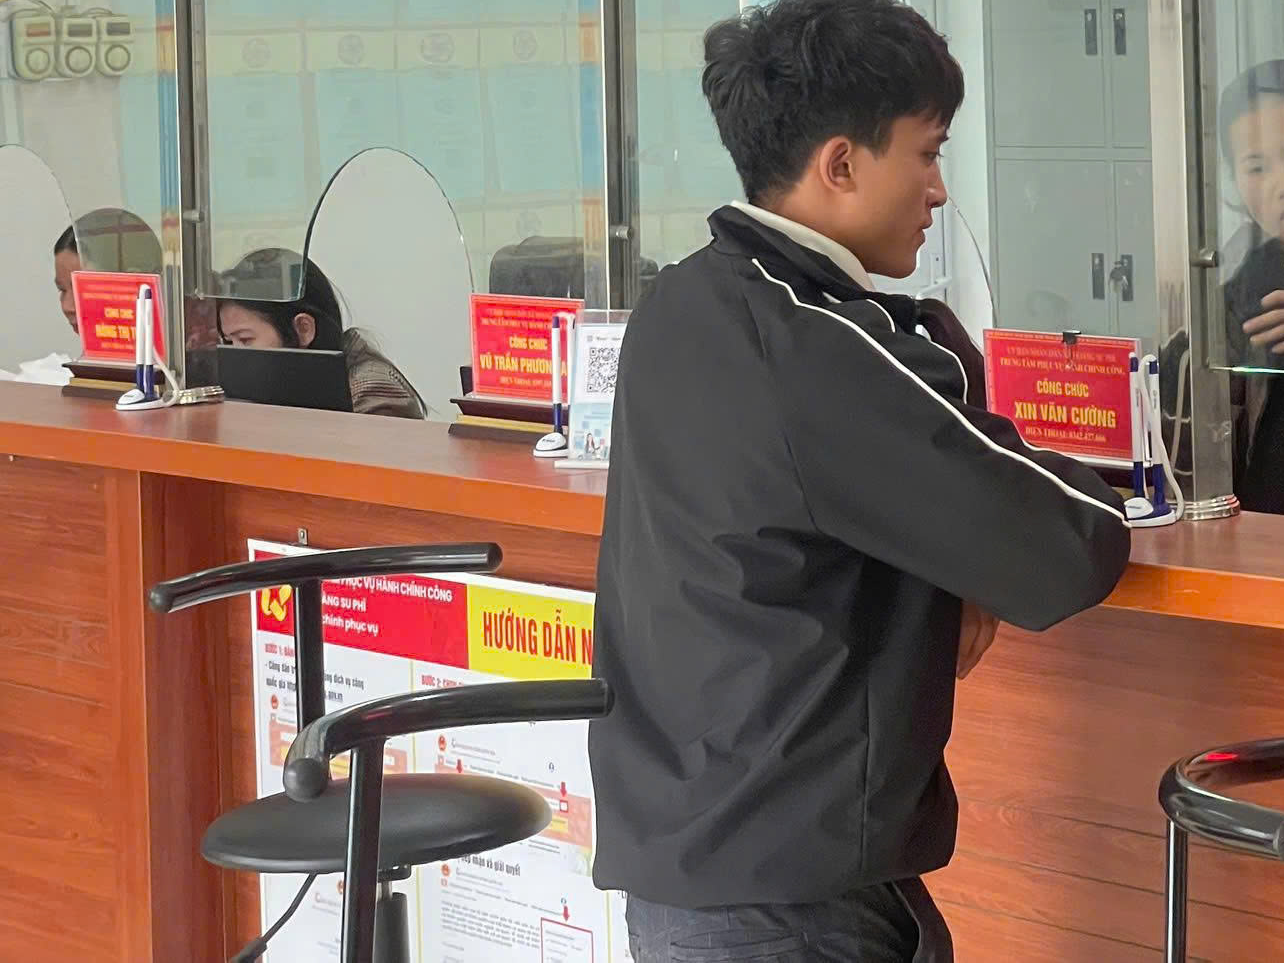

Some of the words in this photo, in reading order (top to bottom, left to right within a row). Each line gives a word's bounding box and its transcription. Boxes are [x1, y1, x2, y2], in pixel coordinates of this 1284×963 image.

[1037, 378, 1062, 396] CÔNG
[1065, 381, 1089, 398] CHỨC
[1015, 401, 1038, 421] XIN
[1040, 401, 1067, 423] VĂN
[1071, 404, 1117, 428] CƯỜNG
[376, 576, 400, 594] HÀNH
[400, 581, 427, 598] CHÍNH
[427, 584, 453, 602] CÔNG
[341, 598, 352, 609] SU
[345, 618, 367, 635] phục
[483, 607, 538, 655] HƯỚNG
[542, 608, 577, 663] DẪN
